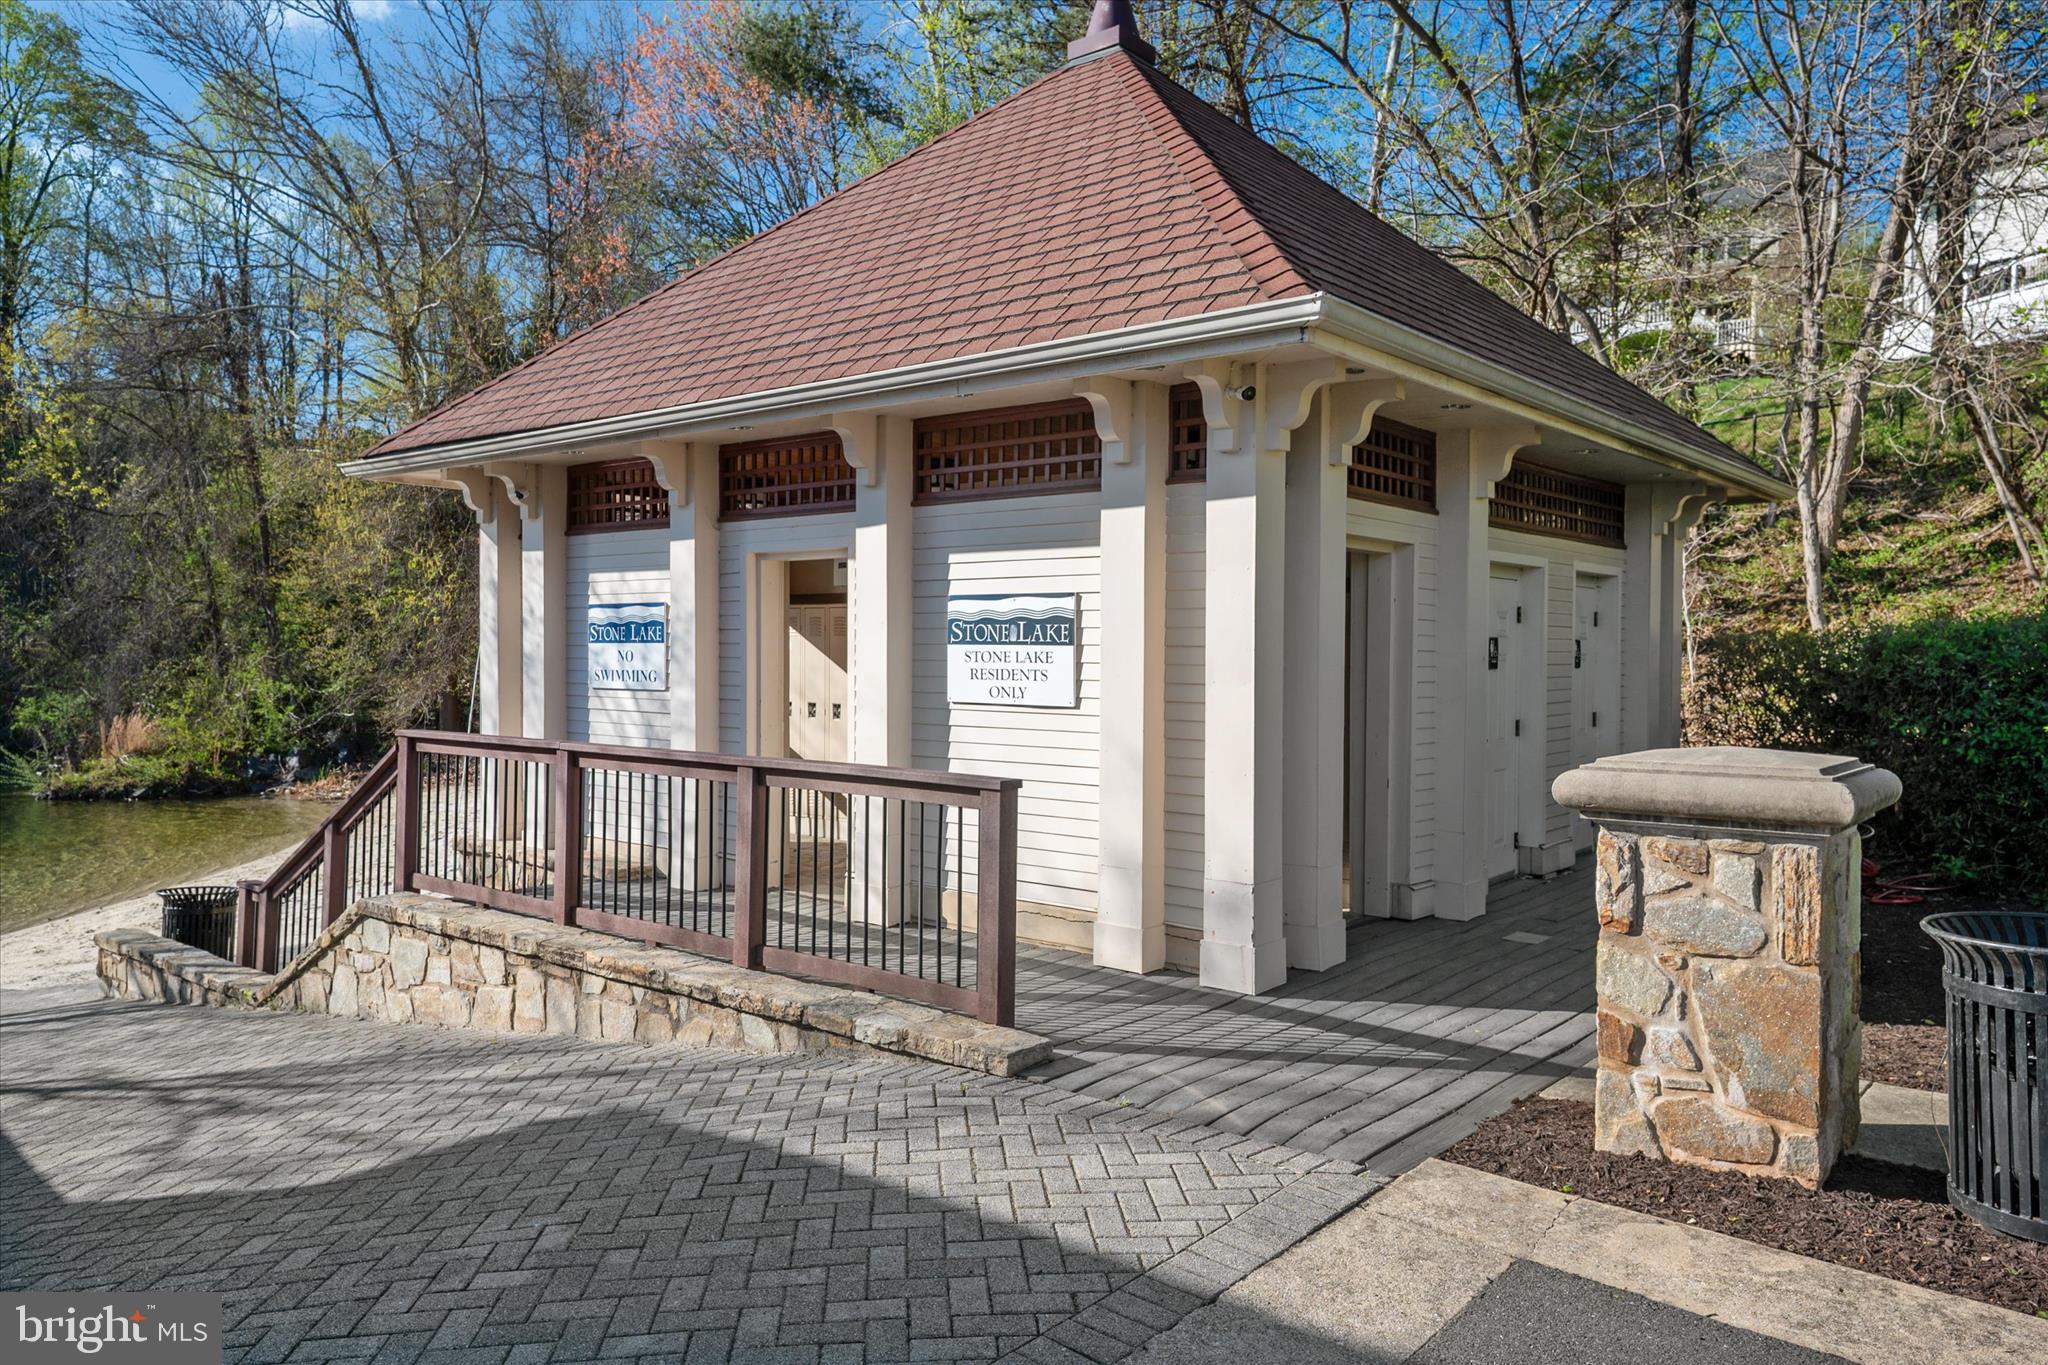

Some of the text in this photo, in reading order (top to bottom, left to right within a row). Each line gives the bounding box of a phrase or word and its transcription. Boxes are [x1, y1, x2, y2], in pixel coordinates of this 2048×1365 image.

[590, 624, 662, 642] STONE LAKE
[950, 620, 1070, 644] STONE LAKE
[617, 650, 634, 662] NO
[964, 650, 1054, 664] STONE LAKE
[594, 669, 657, 682] SWIMMING
[970, 668, 1048, 681] RESIDENTS
[989, 686, 1027, 699] ONLY
